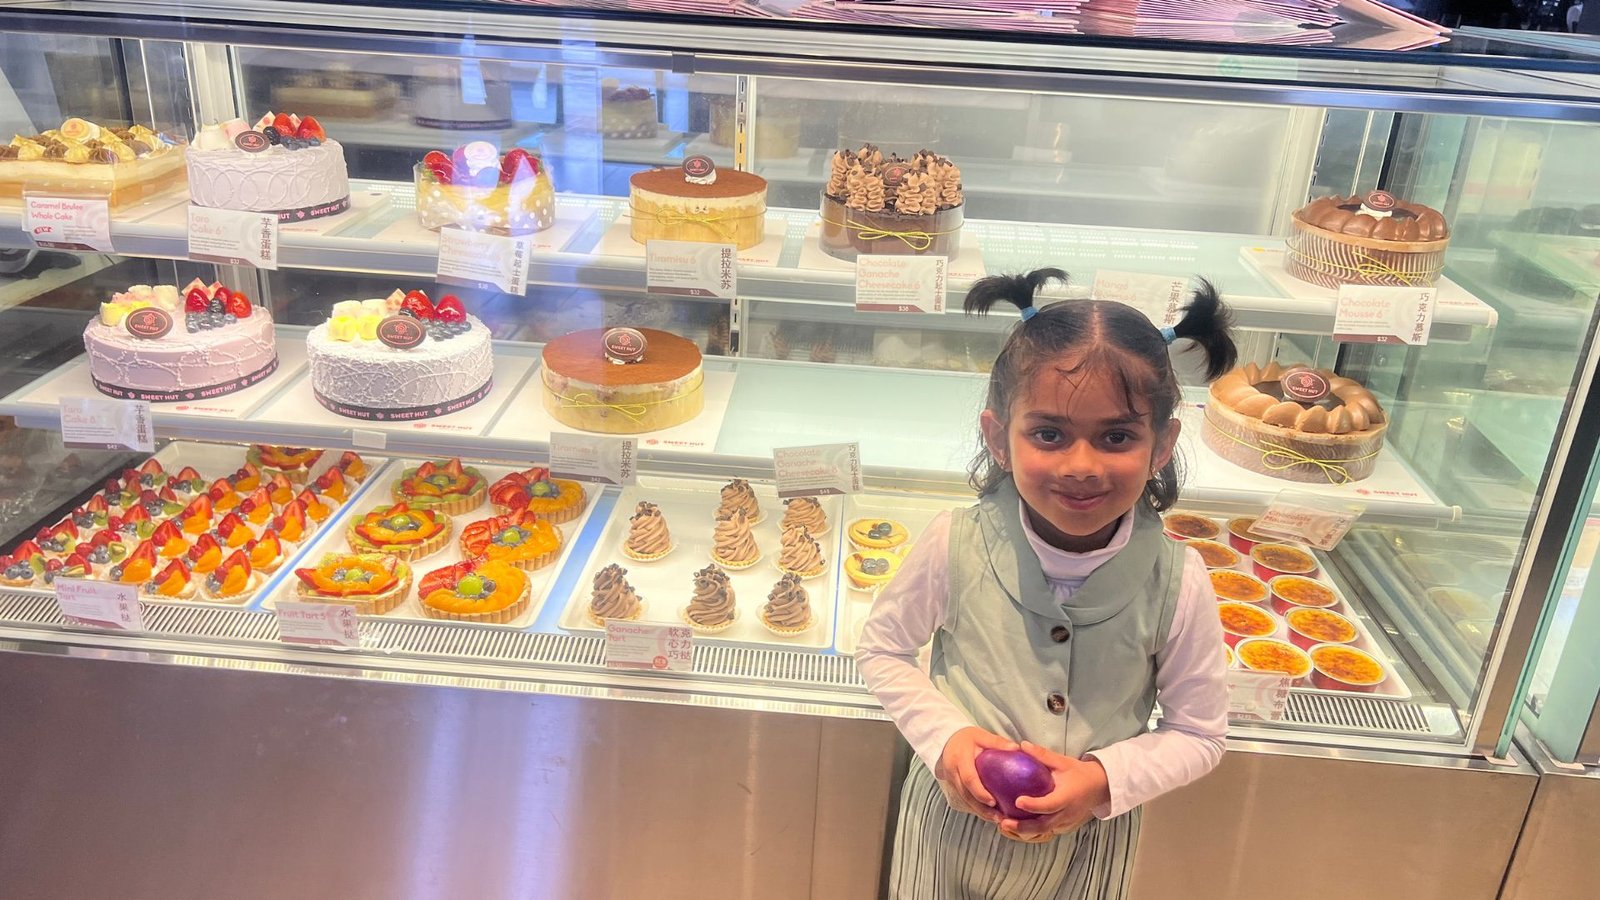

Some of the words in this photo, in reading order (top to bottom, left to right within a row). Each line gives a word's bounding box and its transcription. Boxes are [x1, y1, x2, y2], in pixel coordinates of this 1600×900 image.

[31, 201, 60, 210] Caramel
[62, 203, 84, 211] Brulee
[310, 207, 330, 216] SWEET
[31, 211, 53, 220] Whole
[54, 212, 73, 221] Cake
[191, 213, 210, 223] Taro
[190, 223, 213, 234] Cake
[261, 217, 272, 260] 芋香蛋糕
[859, 257, 907, 268] Chocolate
[720, 248, 732, 290] 提拉米苏
[859, 269, 901, 279] Ganache
[1096, 279, 1129, 291] Mango
[1163, 281, 1183, 324] 芒果慕斯
[1340, 298, 1391, 308] Chocolate
[1339, 309, 1374, 319] Mousse
[1411, 292, 1430, 342] 巧克力慕斯
[251, 371, 267, 382] SWEET
[99, 385, 113, 394] SWEET
[201, 387, 224, 398] SWEET
[447, 401, 466, 412] SWEET
[338, 407, 357, 418] SWEET
[64, 414, 88, 424] Cake
[621, 441, 632, 479] 提拉米苏
[57, 583, 75, 592] Mini
[76, 585, 97, 594] Fruit
[277, 609, 300, 618] Fruit
[300, 610, 319, 620] Tart
[607, 624, 648, 634] Ganache
[607, 633, 626, 642] Tart
